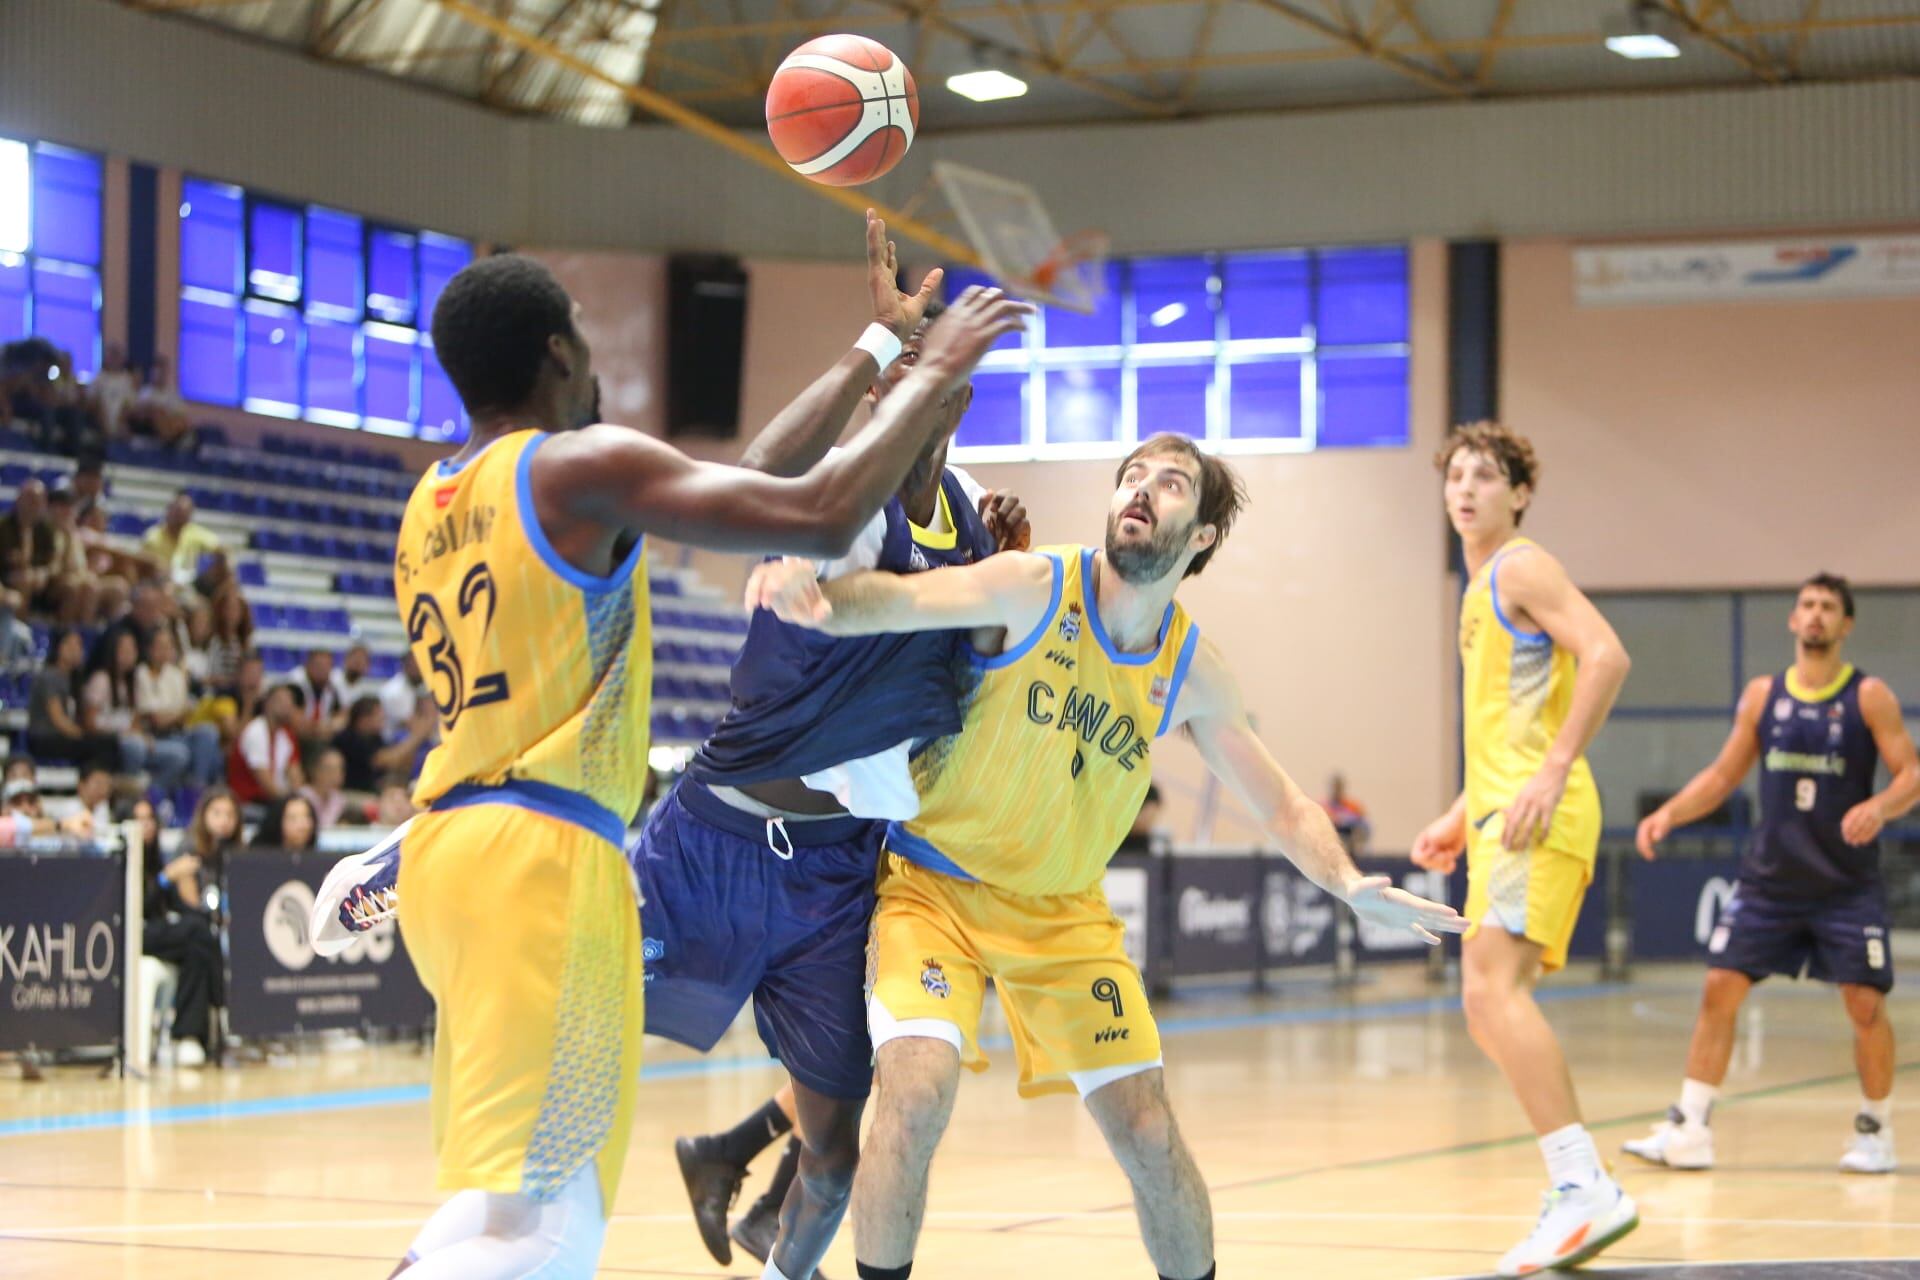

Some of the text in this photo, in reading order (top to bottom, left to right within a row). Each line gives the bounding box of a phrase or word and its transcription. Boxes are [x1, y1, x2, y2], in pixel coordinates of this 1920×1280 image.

[407, 560, 510, 732] 32
[1026, 679, 1150, 773] CANOE
[1795, 777, 1817, 812] 9
[0, 920, 114, 981] KAHLO
[1091, 976, 1125, 1017] 9
[1094, 1026, 1130, 1044] vive
